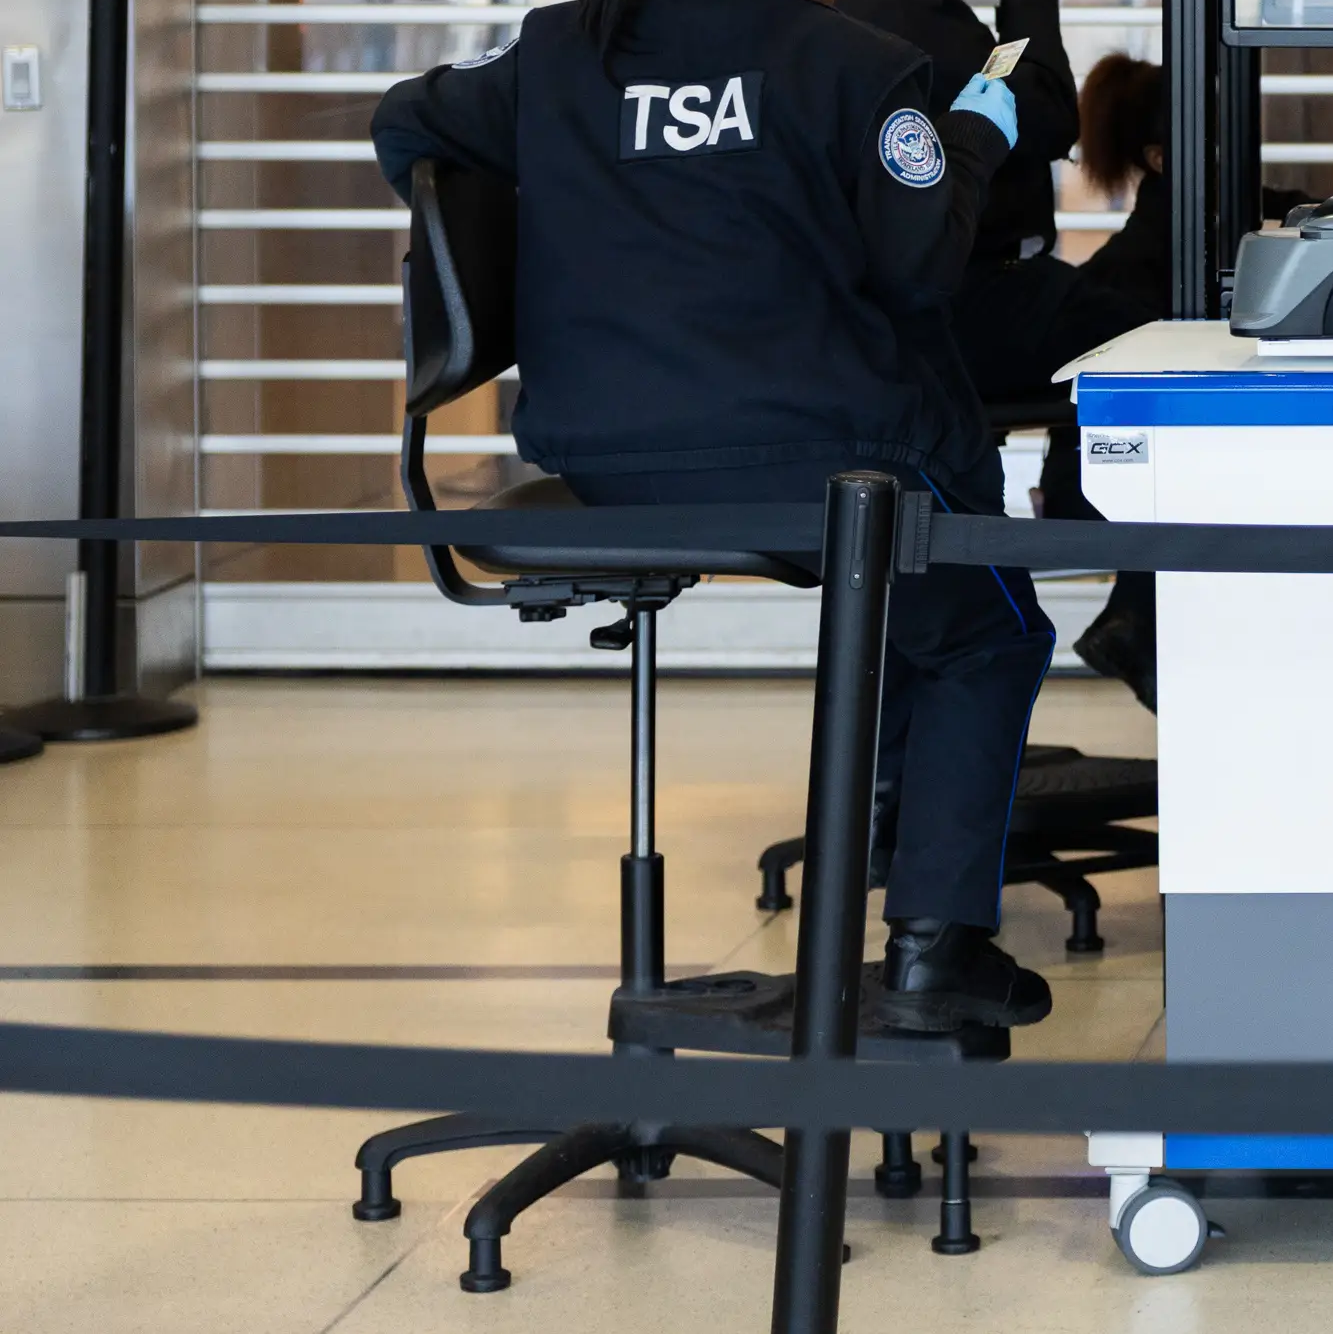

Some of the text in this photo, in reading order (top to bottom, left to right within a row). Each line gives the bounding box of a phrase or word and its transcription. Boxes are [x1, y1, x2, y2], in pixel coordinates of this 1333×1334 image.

[624, 77, 754, 151] TSA
[884, 114, 914, 161] TRANSPORTATION
[915, 116, 937, 143] SECURITY
[900, 158, 942, 181] ADMINISTRATION
[1090, 442, 1144, 454] GCX
